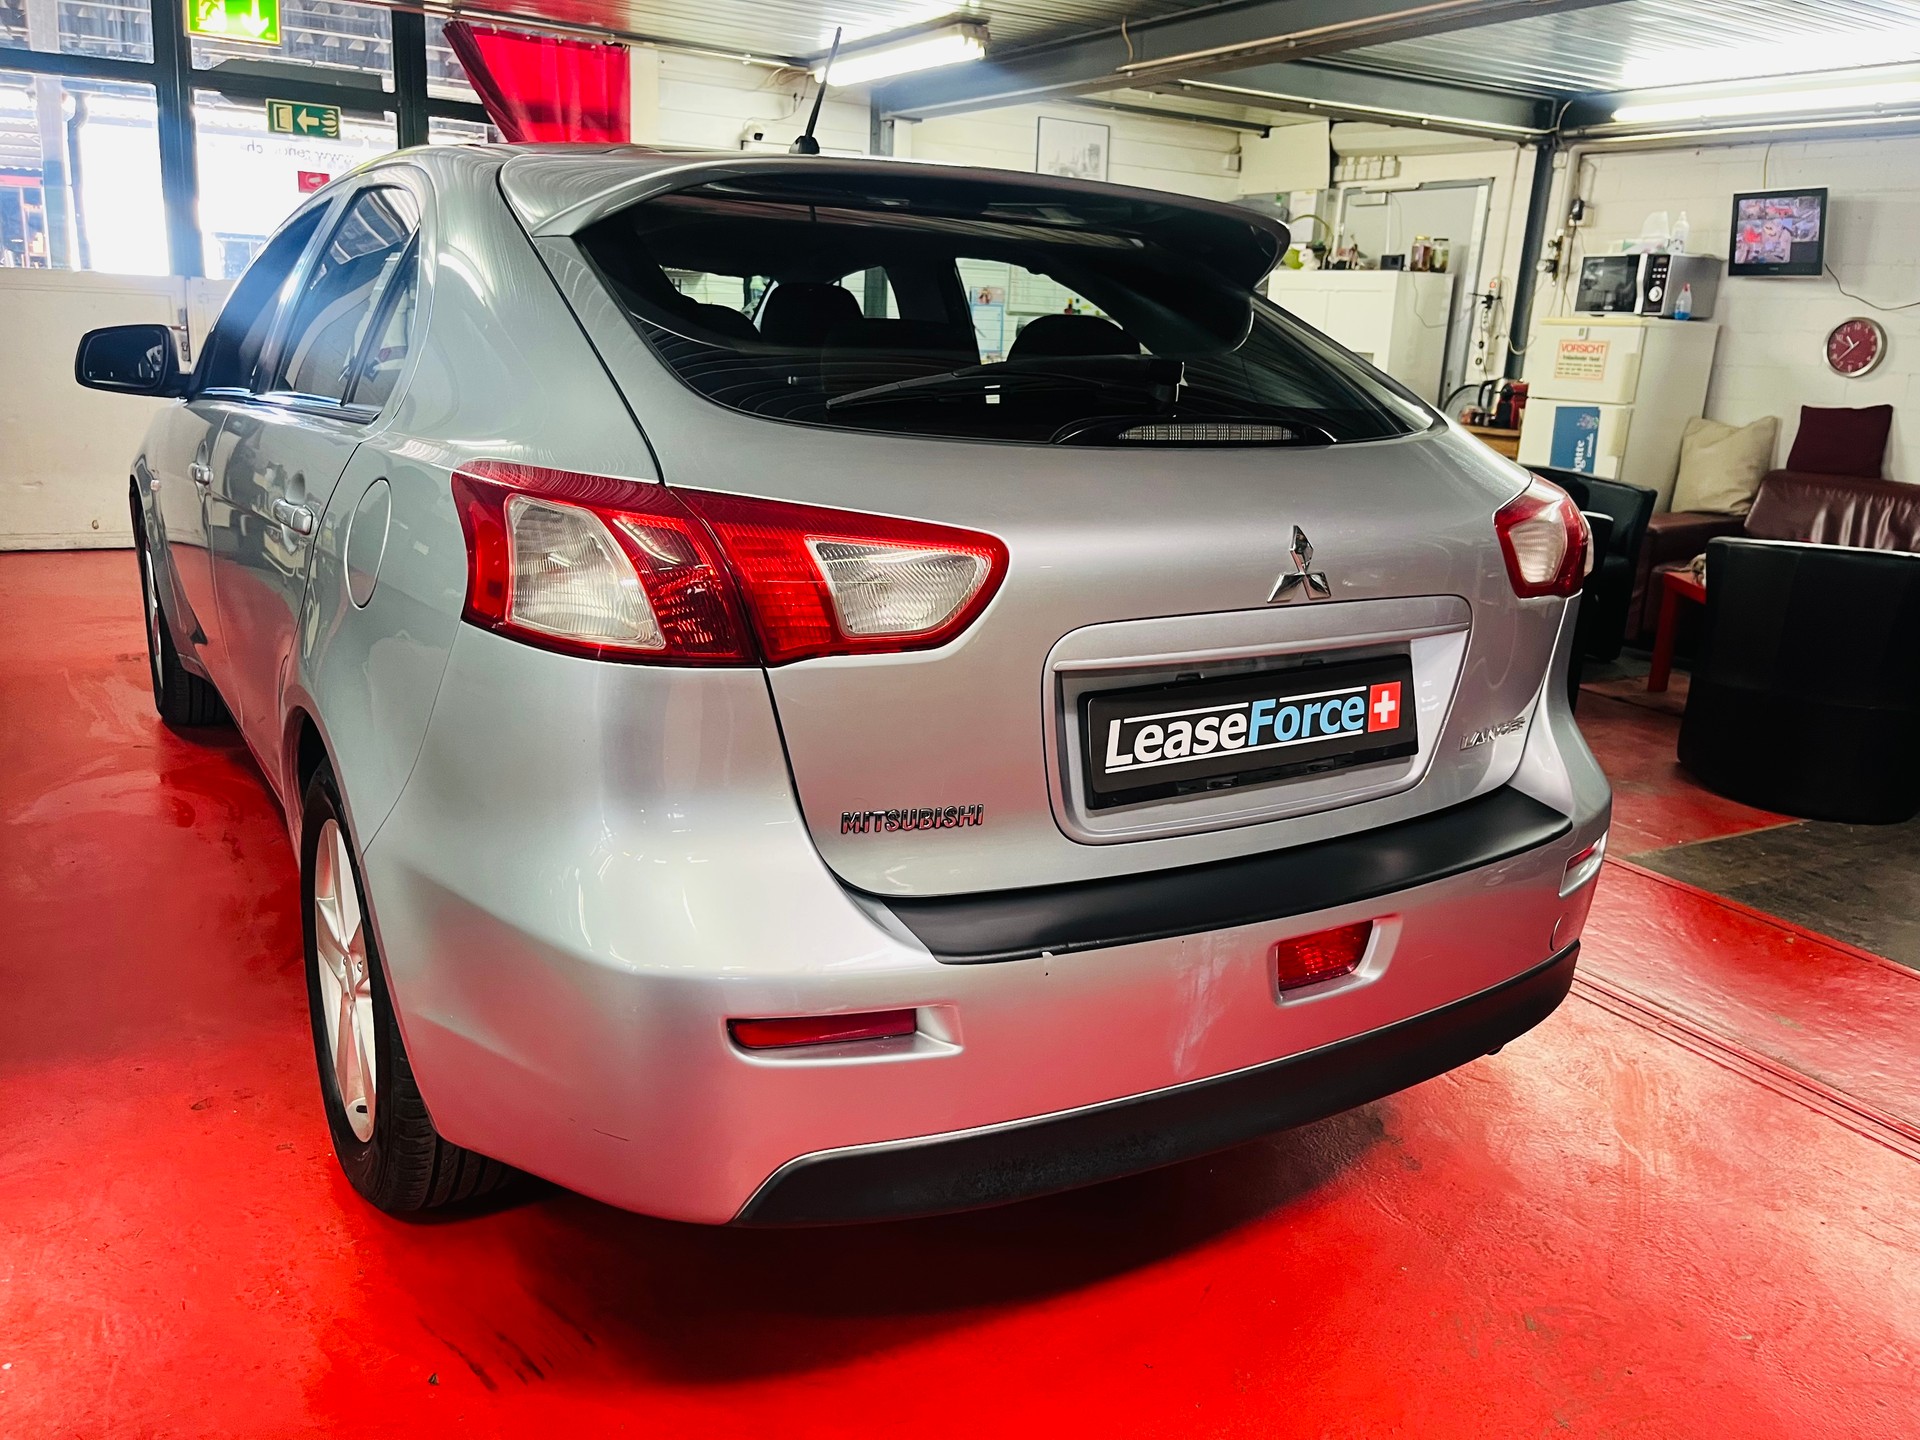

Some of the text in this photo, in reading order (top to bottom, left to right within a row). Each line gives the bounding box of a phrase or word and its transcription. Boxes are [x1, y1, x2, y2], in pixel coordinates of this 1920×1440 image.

[1561, 343, 1605, 354] VORSICHT
[1104, 695, 1366, 768] LeaseForce
[1459, 716, 1526, 751] LANCER
[840, 803, 985, 835] MITSUBISHI
